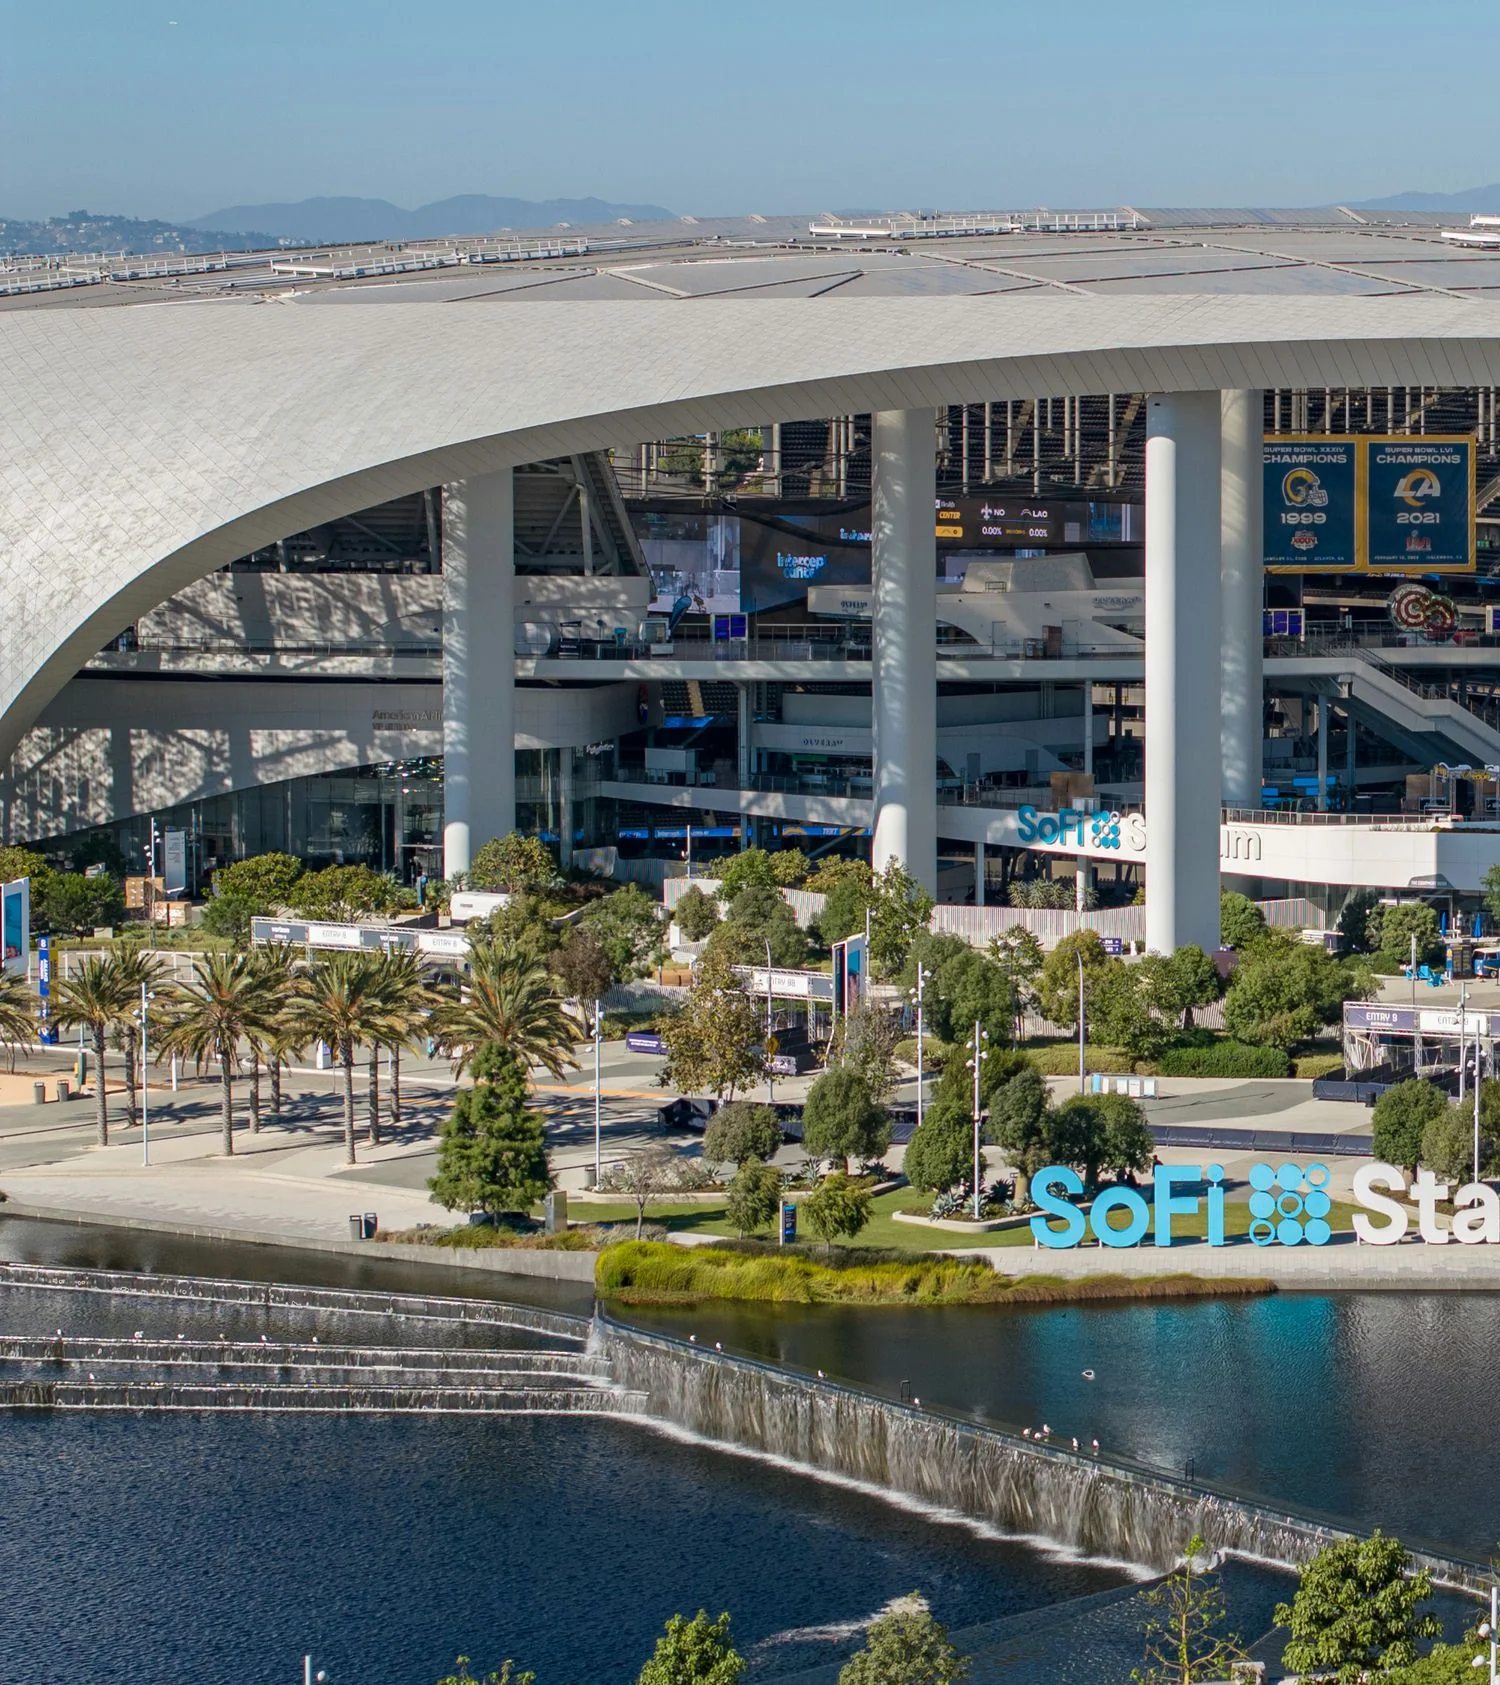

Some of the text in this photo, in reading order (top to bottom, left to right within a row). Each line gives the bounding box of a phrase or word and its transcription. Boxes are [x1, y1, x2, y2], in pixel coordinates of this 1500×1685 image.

[1263, 455, 1347, 463] CHAMPIONS
[1376, 455, 1461, 464] CHAMPIONS
[1280, 513, 1327, 524] 1999
[1396, 513, 1440, 524] 2021
[982, 527, 1002, 535] 0.00%
[1029, 529, 1048, 537] 0.00%
[1018, 805, 1085, 847] SoFi
[1366, 1012, 1398, 1022] ENTRY 9
[1030, 1164, 1225, 1247] SoFi
